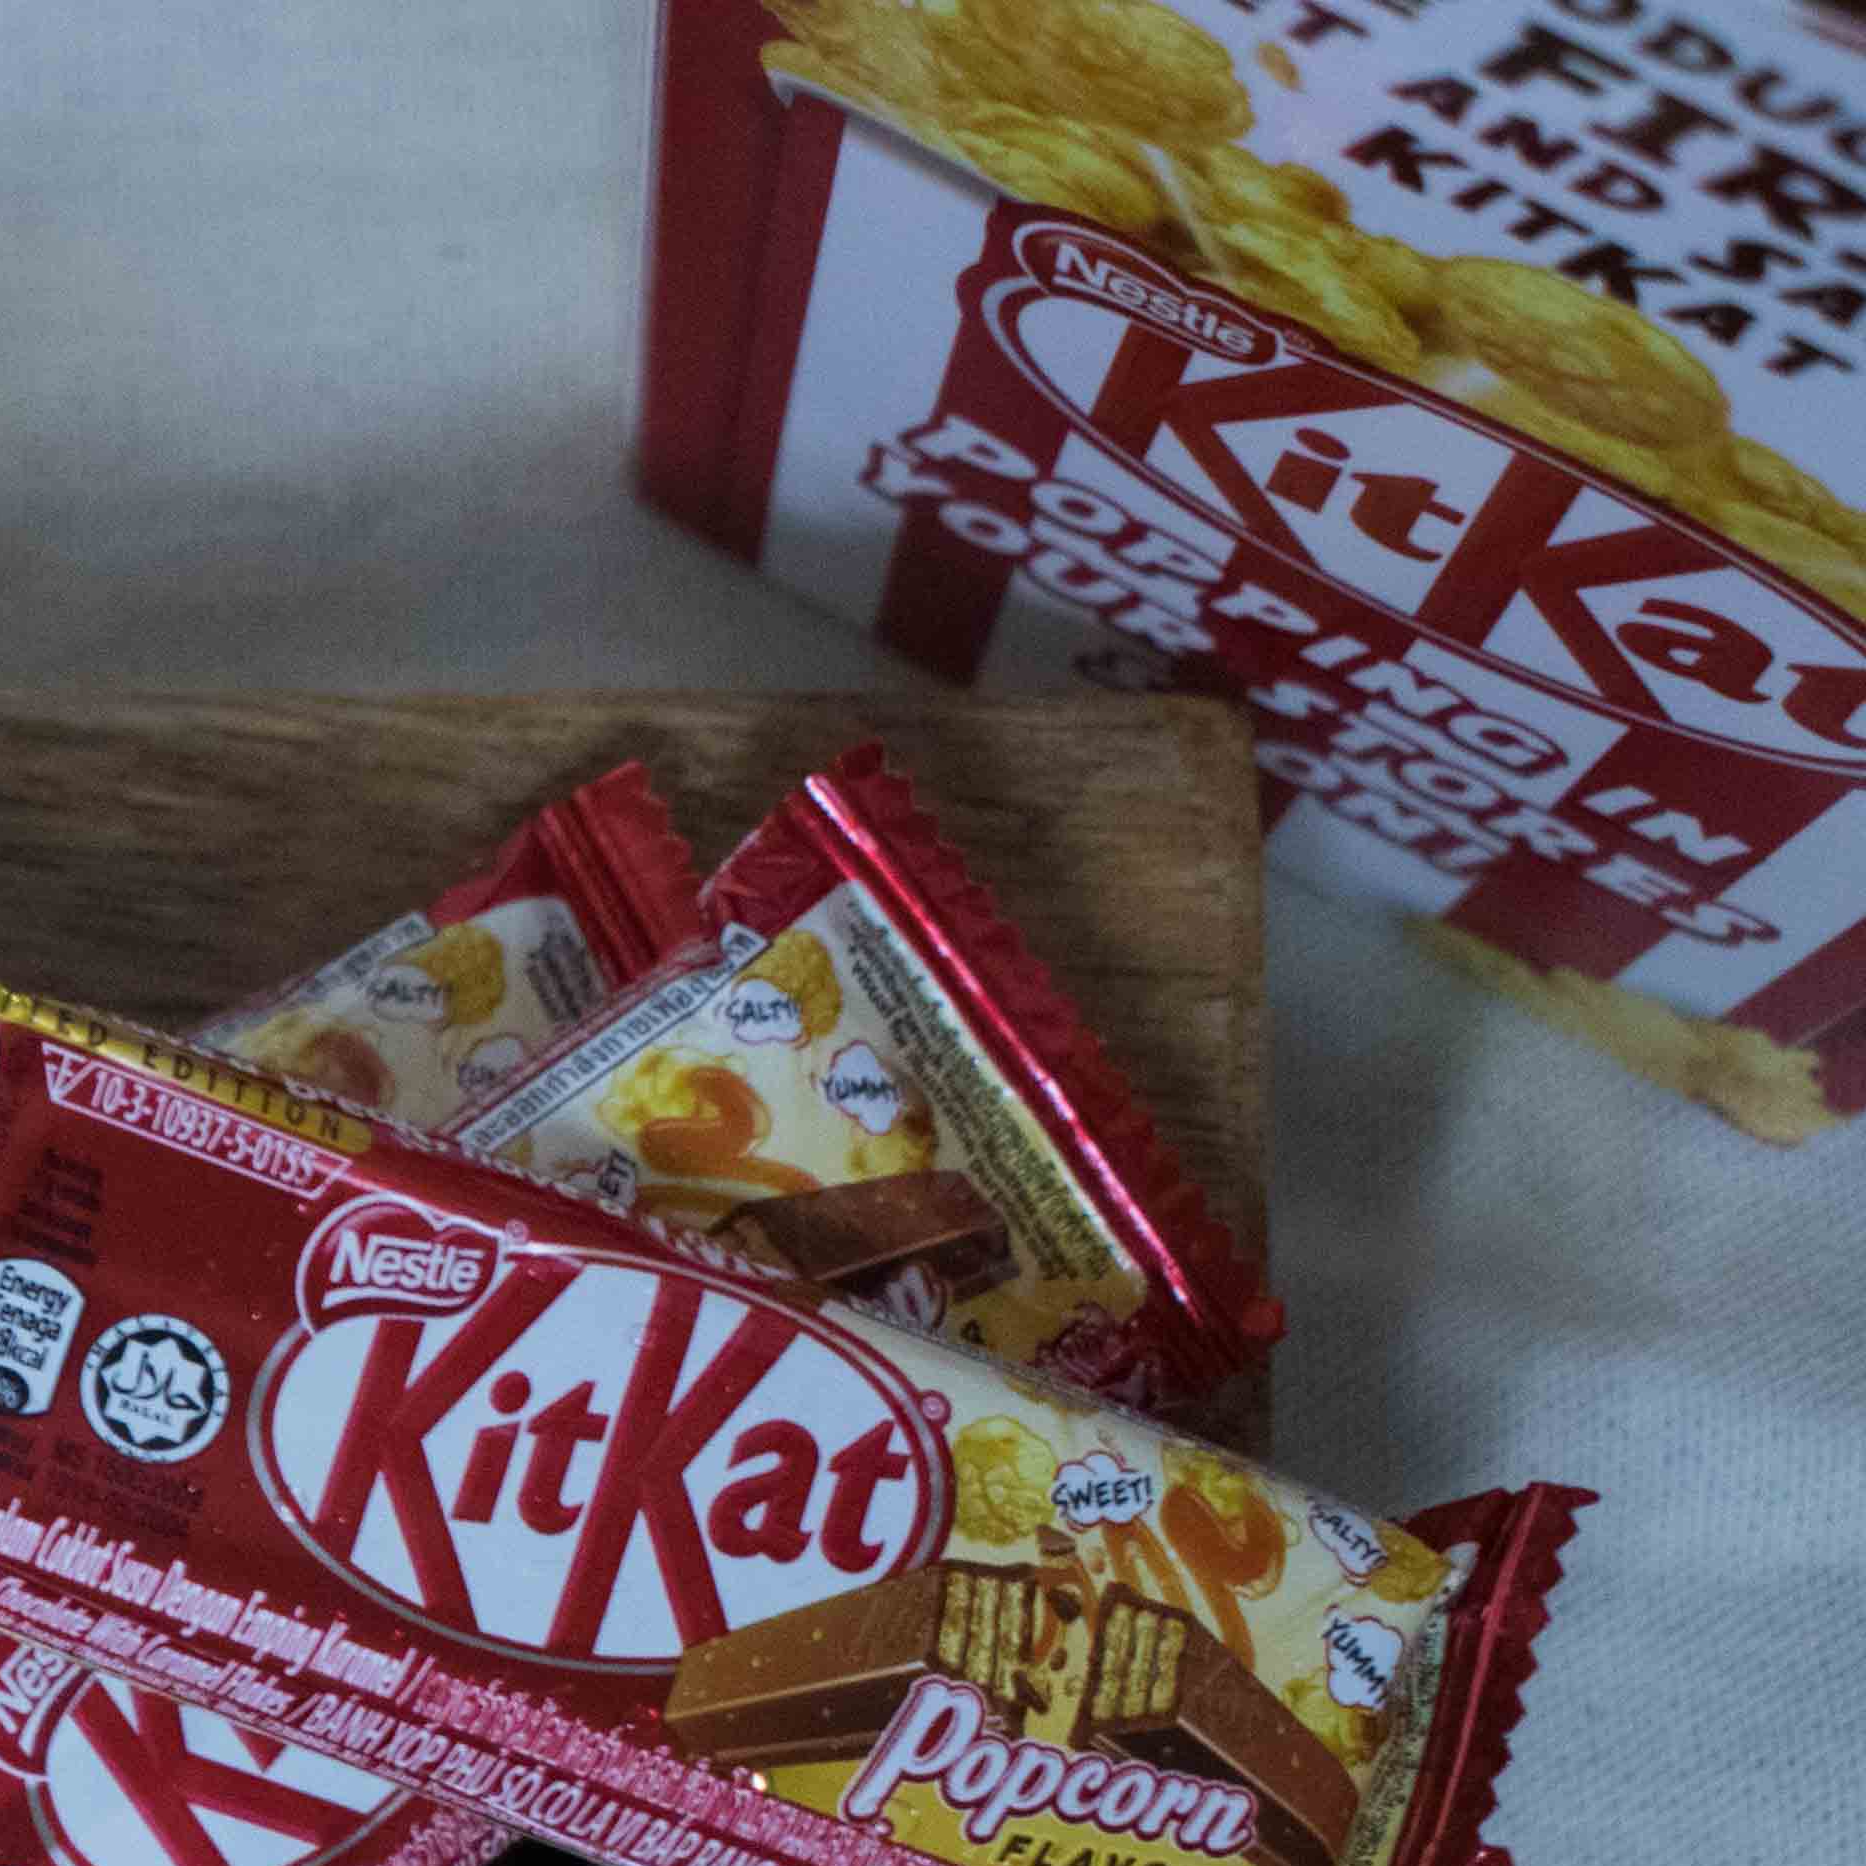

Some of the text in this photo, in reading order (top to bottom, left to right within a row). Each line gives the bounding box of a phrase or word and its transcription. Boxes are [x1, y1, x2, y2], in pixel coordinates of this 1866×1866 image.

[1387, 71, 1668, 212] AND
[1477, 23, 1866, 271] FIR
[1052, 242, 1259, 361] Nestlé
[1341, 125, 1856, 378] KITKAT
[862, 443, 1783, 948] YOUR STORES
[909, 412, 1753, 867] POPPING IN
[85, 1070, 323, 1187] 10-3-10937-5-0155
[137, 1043, 348, 1142] EDITION
[329, 1229, 482, 1293] Nestlé
[312, 1257, 915, 1660] KitKat
[1052, 1475, 1154, 1511] SWEET!
[845, 1676, 1253, 1854] Popcorn
